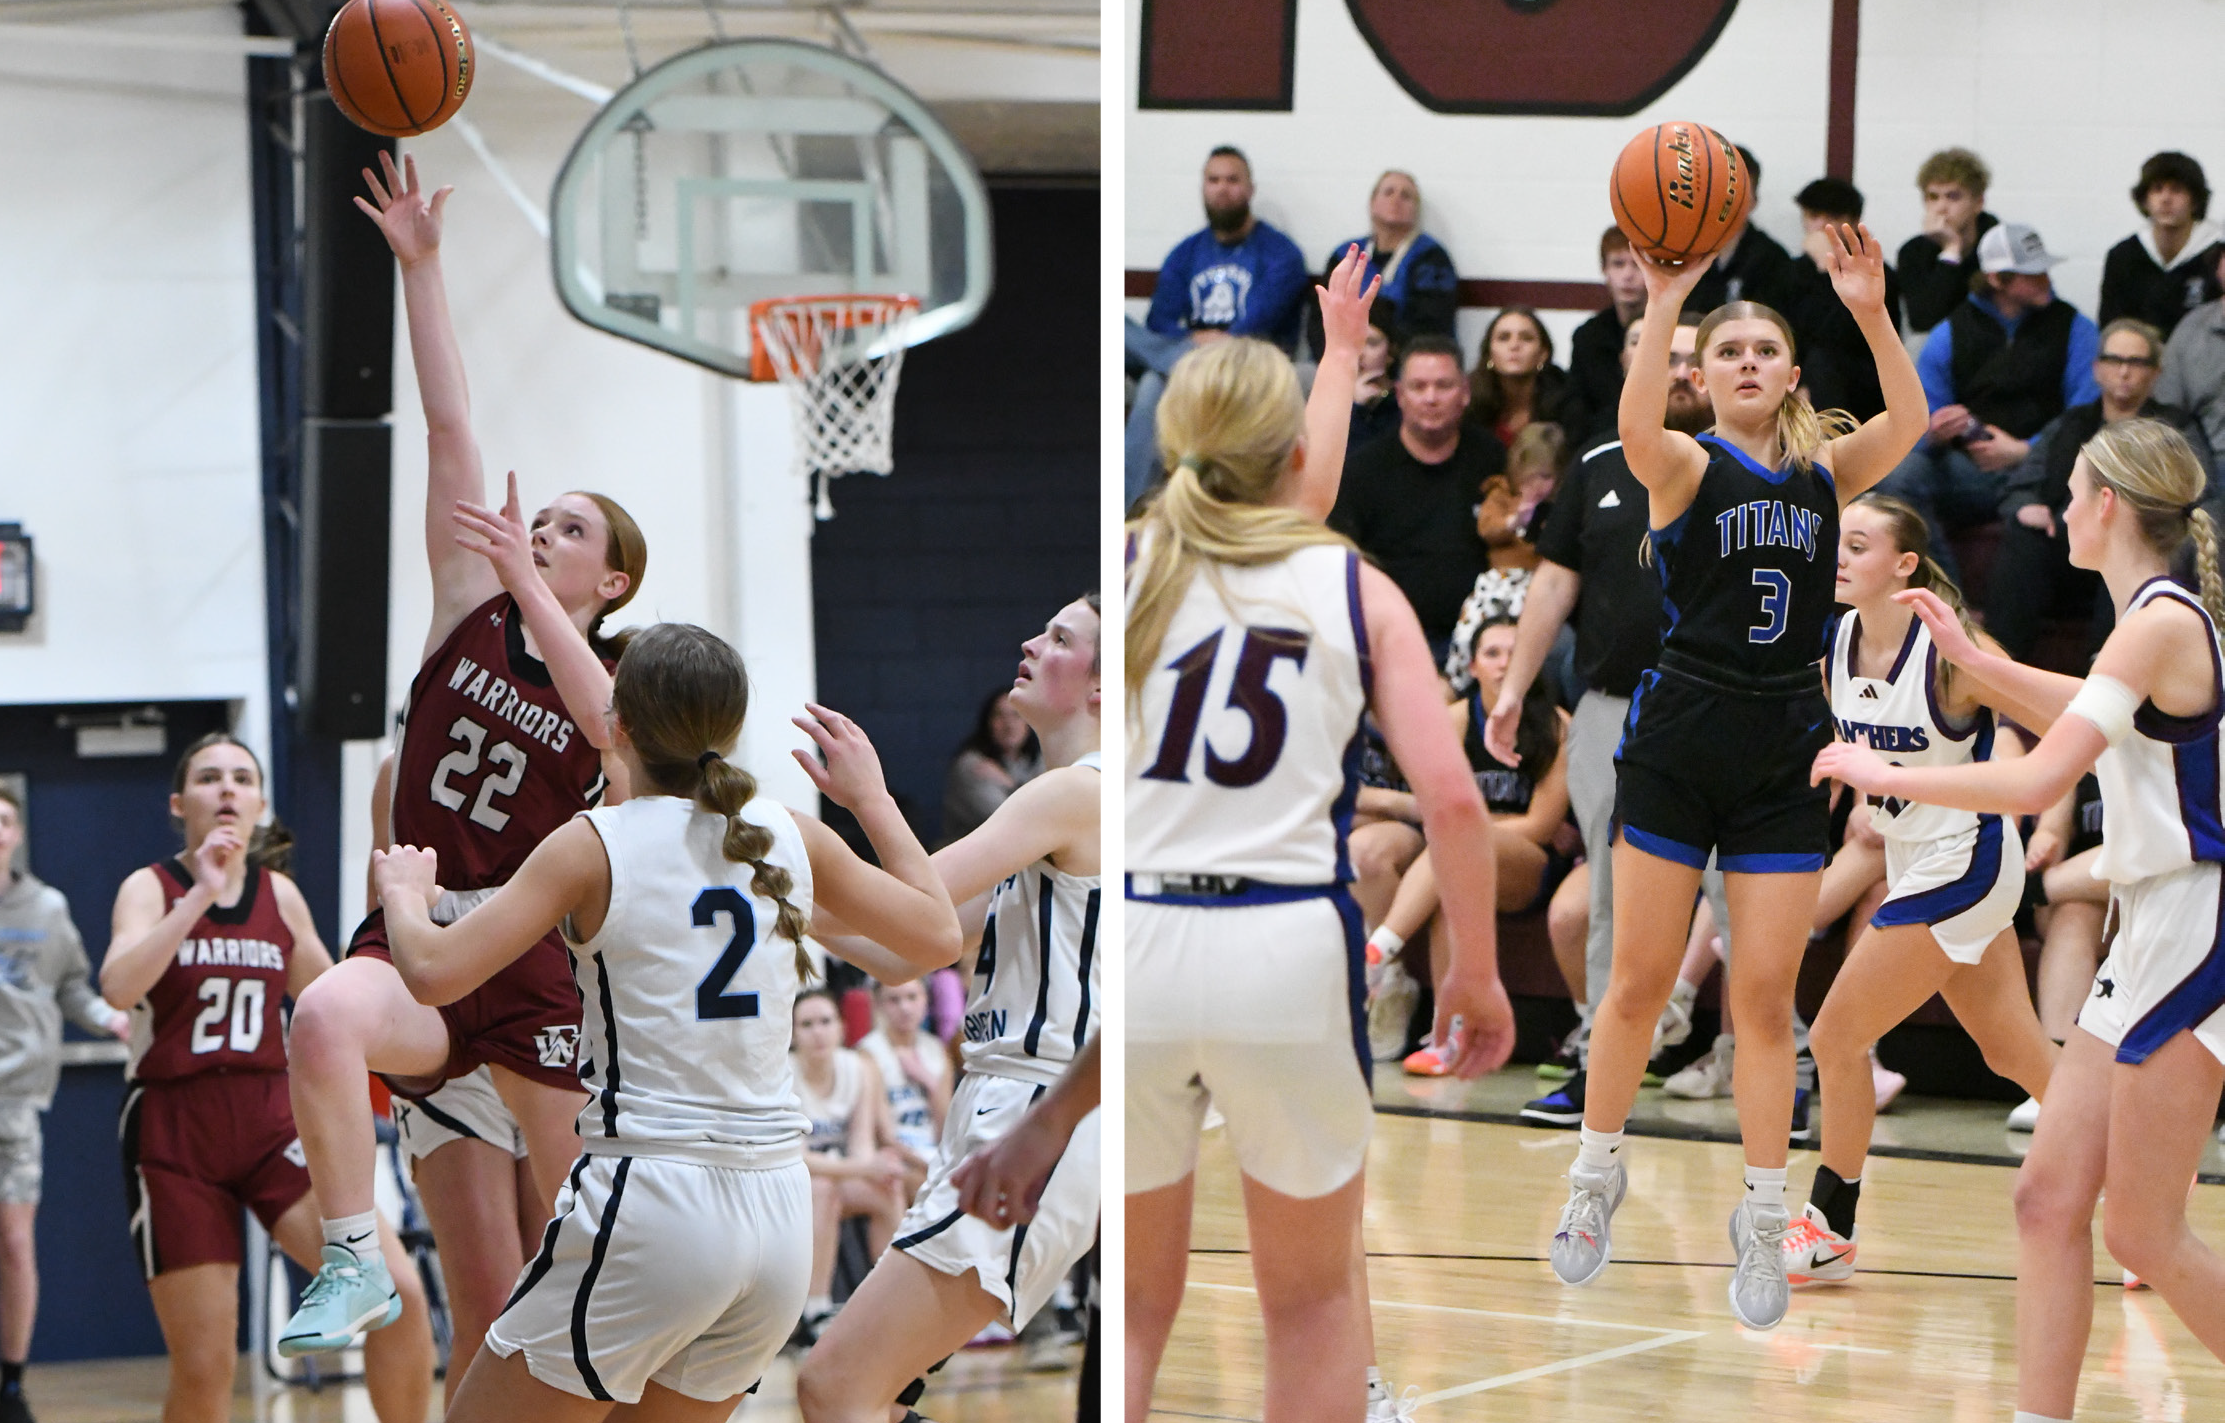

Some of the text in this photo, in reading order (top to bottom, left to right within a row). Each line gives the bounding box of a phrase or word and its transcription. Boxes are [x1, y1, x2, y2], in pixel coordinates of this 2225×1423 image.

[1749, 568, 1792, 644] 3
[447, 656, 575, 754] WARRIORS
[1139, 624, 1315, 788] 15
[430, 716, 528, 832] 22
[178, 937, 284, 971] WARRIORS
[689, 885, 760, 1022] 2
[191, 976, 266, 1054] 20
